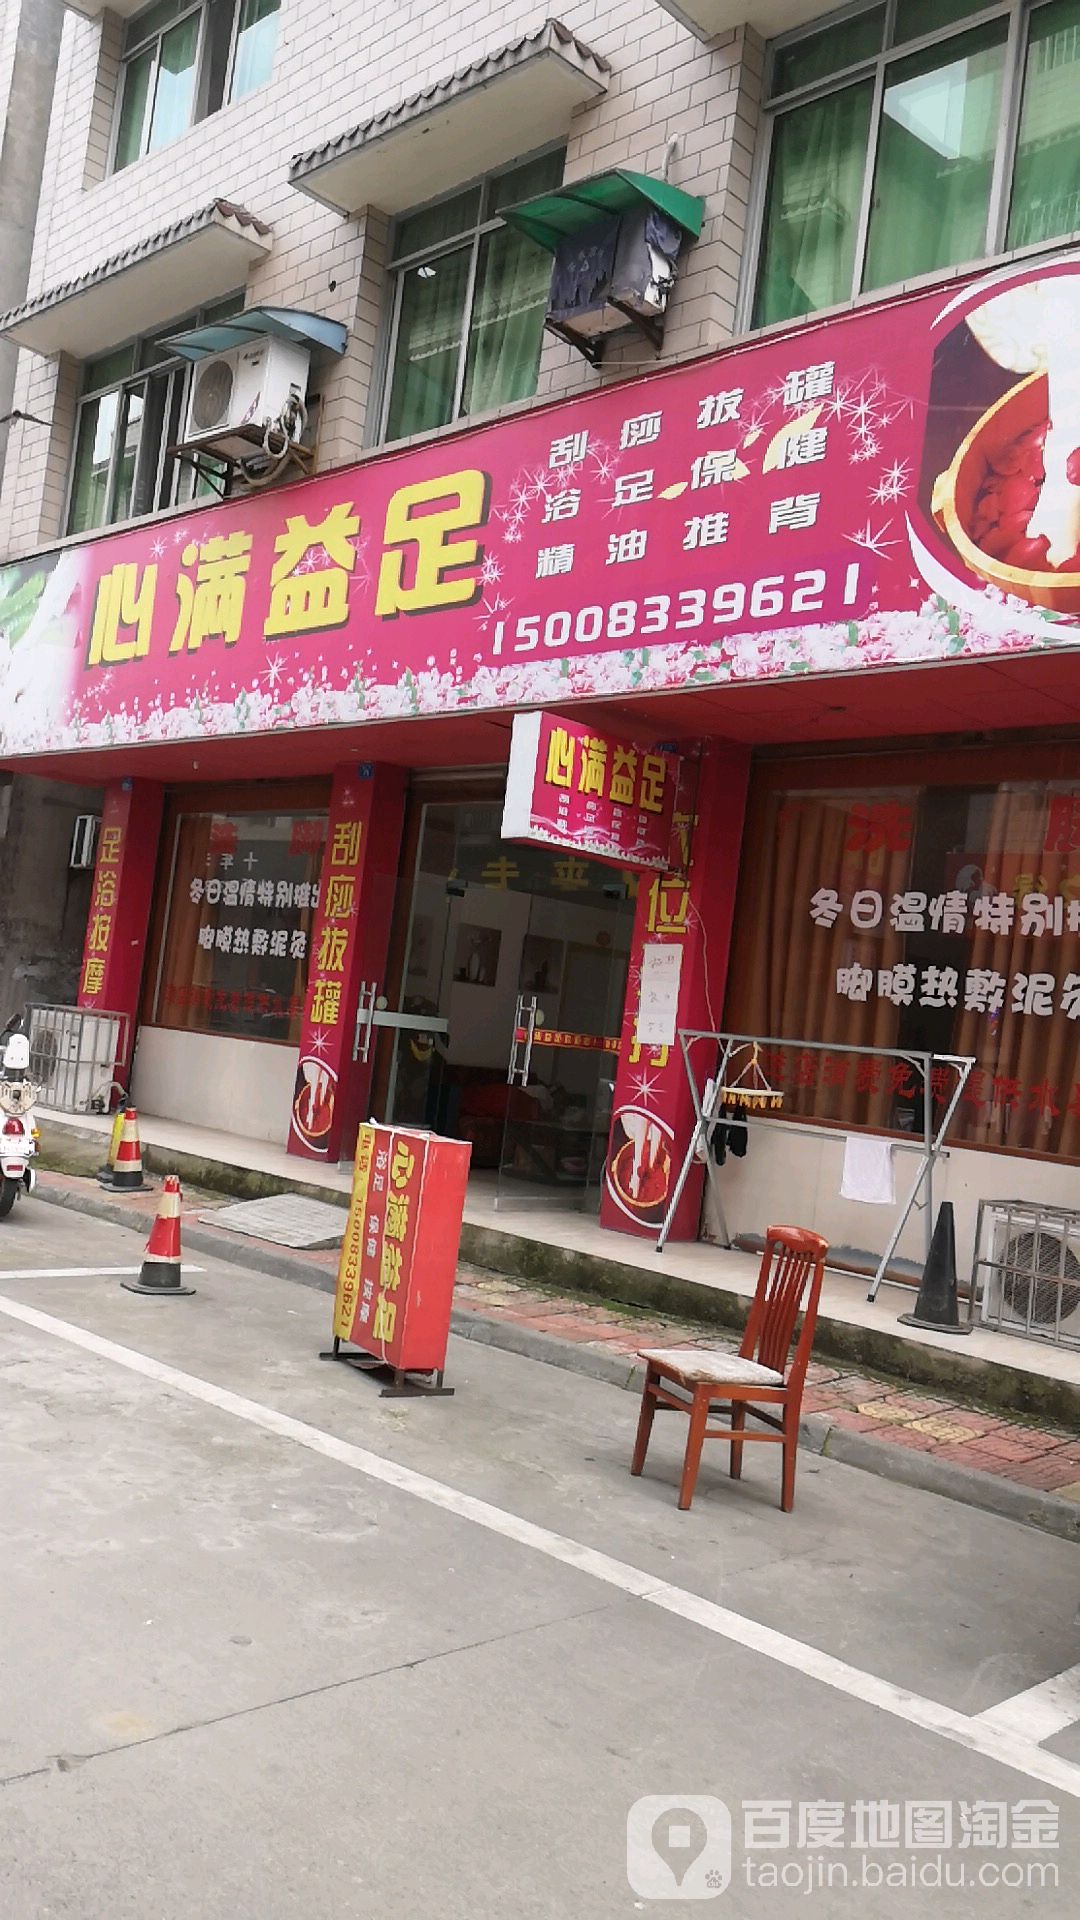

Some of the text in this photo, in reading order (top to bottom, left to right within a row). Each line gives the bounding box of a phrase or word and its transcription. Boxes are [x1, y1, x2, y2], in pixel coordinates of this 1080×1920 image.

[547, 360, 836, 468] 刮痧拔罐
[541, 426, 829, 524] 浴足保健
[87, 469, 490, 668] 心满益足
[535, 493, 822, 580] 精油推背
[491, 562, 861, 656] 15008339621
[545, 726, 668, 814] 心满益足
[82, 826, 122, 995] 足浴按摩
[309, 820, 362, 1026] 刮痧拔罐
[340, 1198, 364, 1329] 15008339621
[372, 1141, 416, 1343] 心满益足
